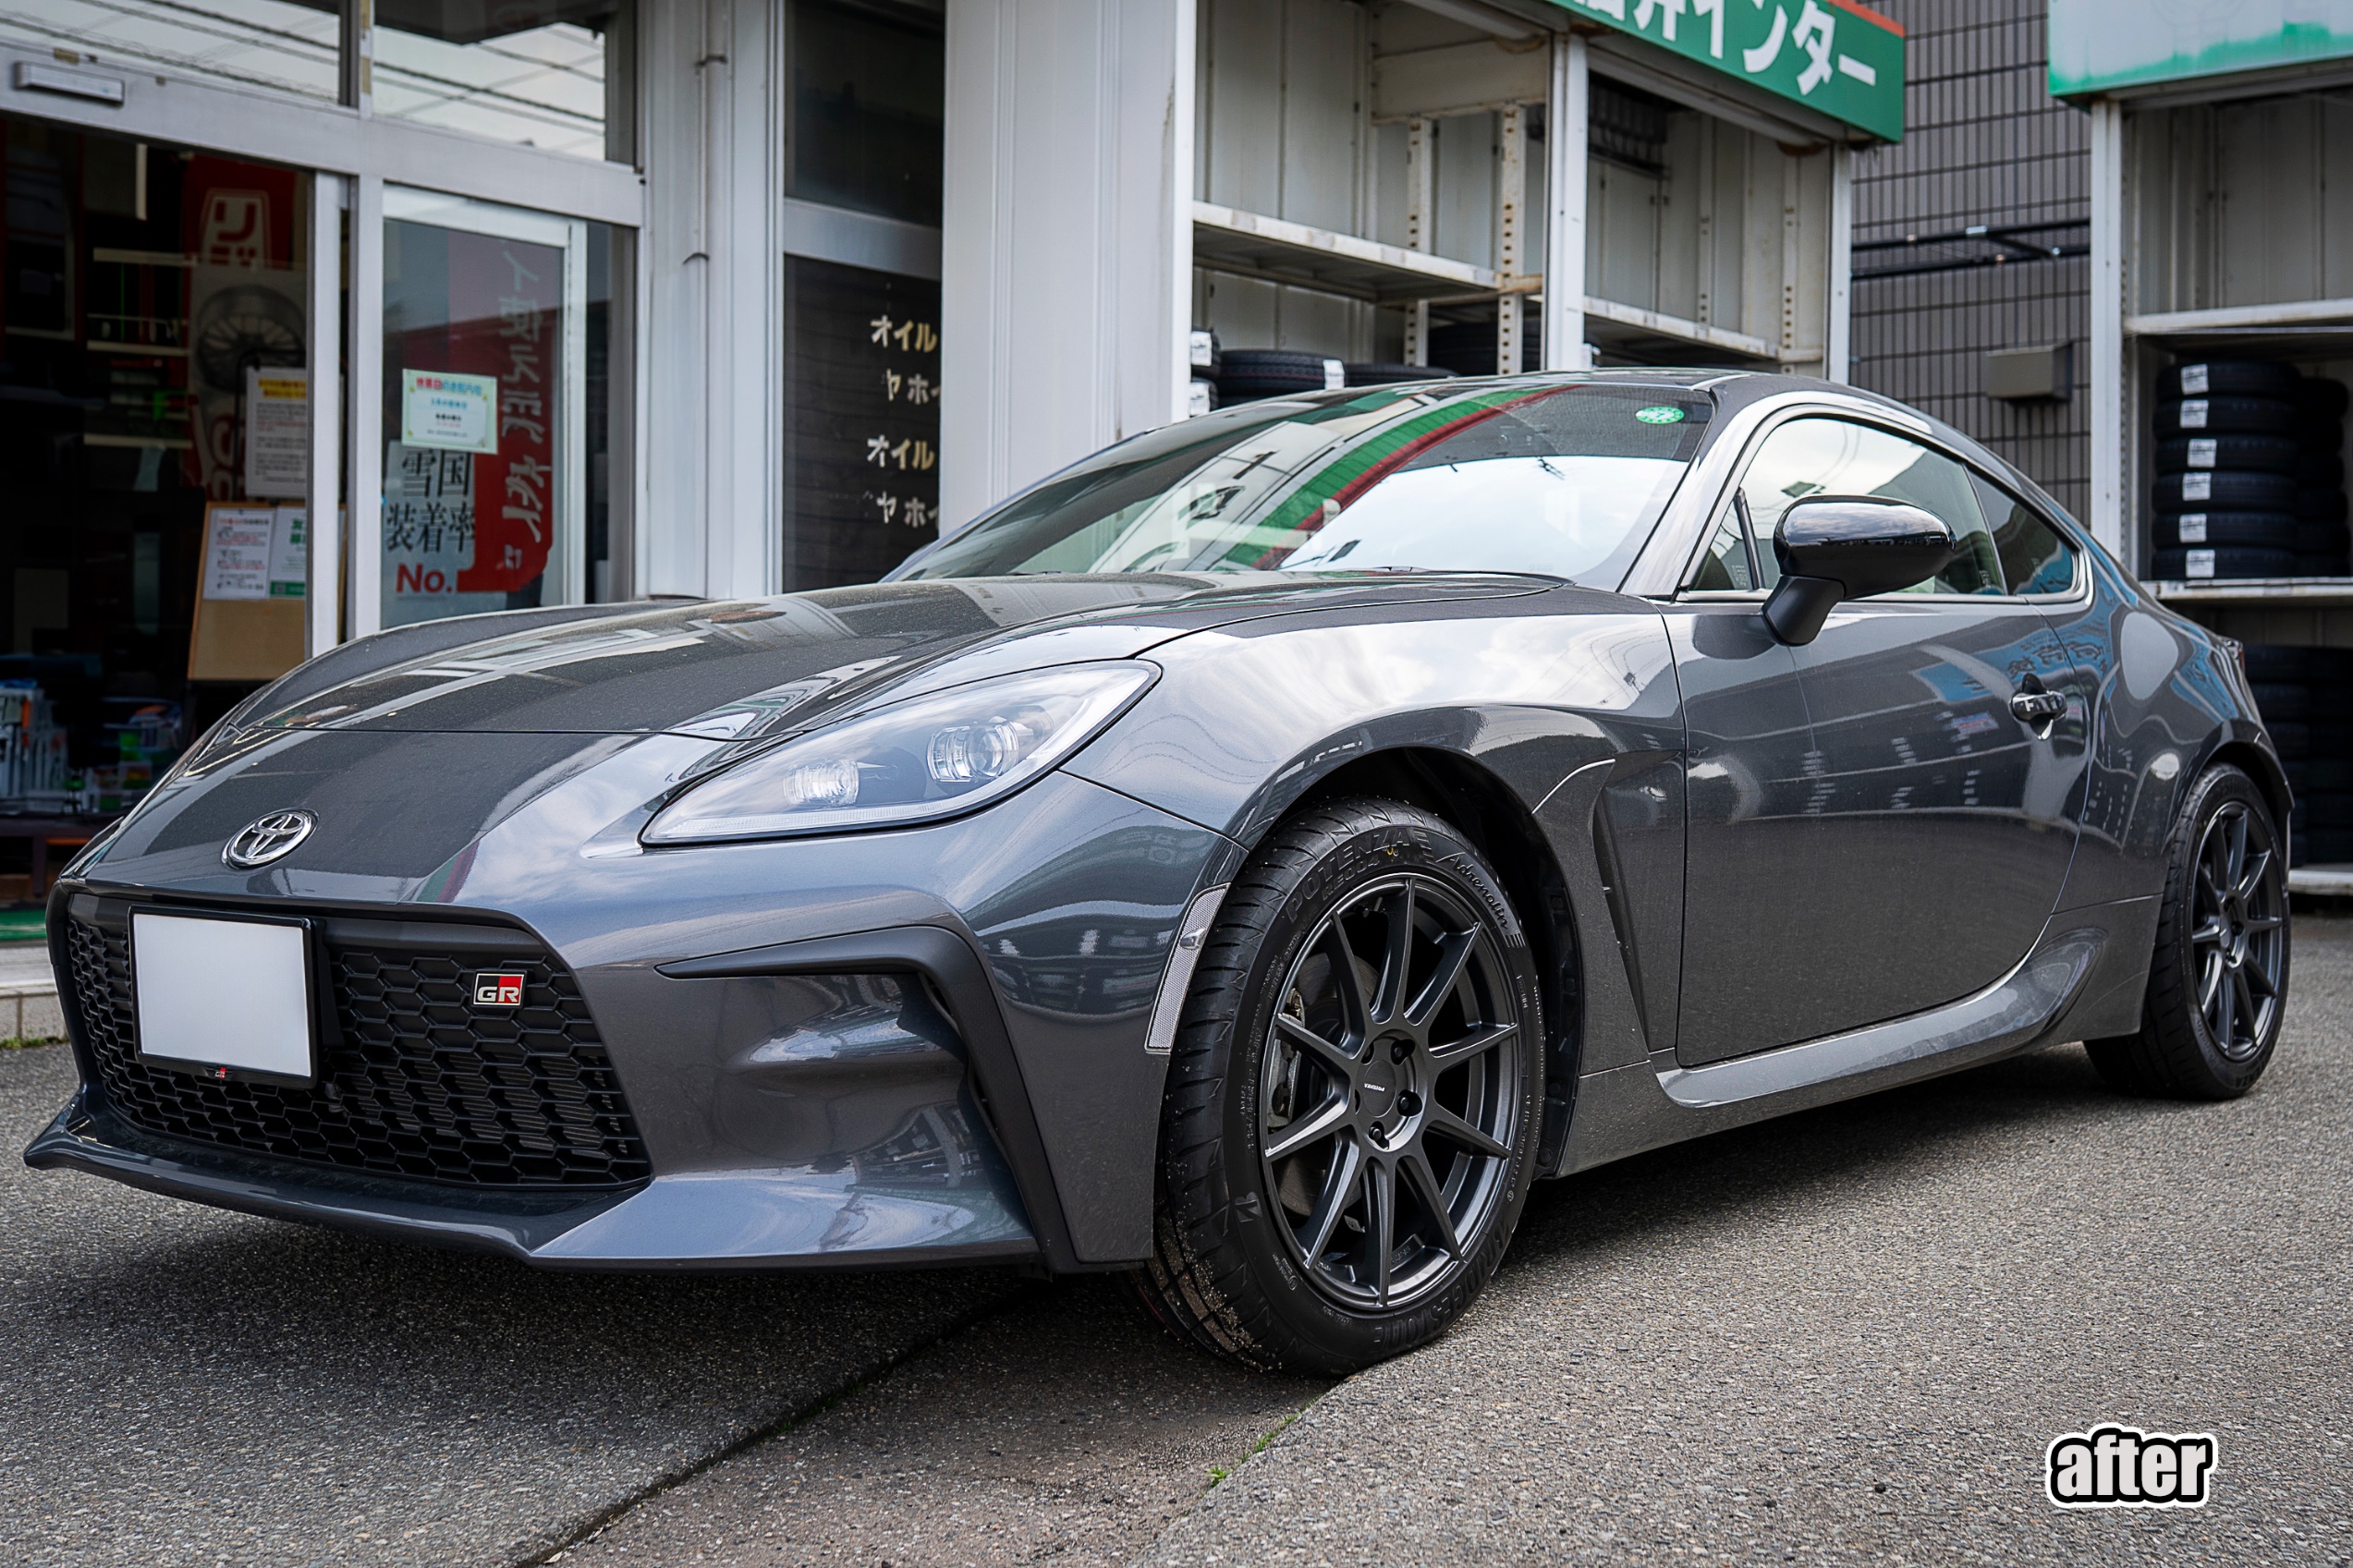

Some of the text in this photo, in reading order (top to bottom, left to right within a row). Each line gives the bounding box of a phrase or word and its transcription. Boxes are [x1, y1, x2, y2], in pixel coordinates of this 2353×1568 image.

[1573, 0, 1876, 96] インター
[870, 314, 938, 353] オイル
[867, 434, 935, 470] オイル
[385, 502, 475, 553] 装着率
[1286, 824, 1410, 924] POTENZA
[477, 986, 519, 1003] GR
